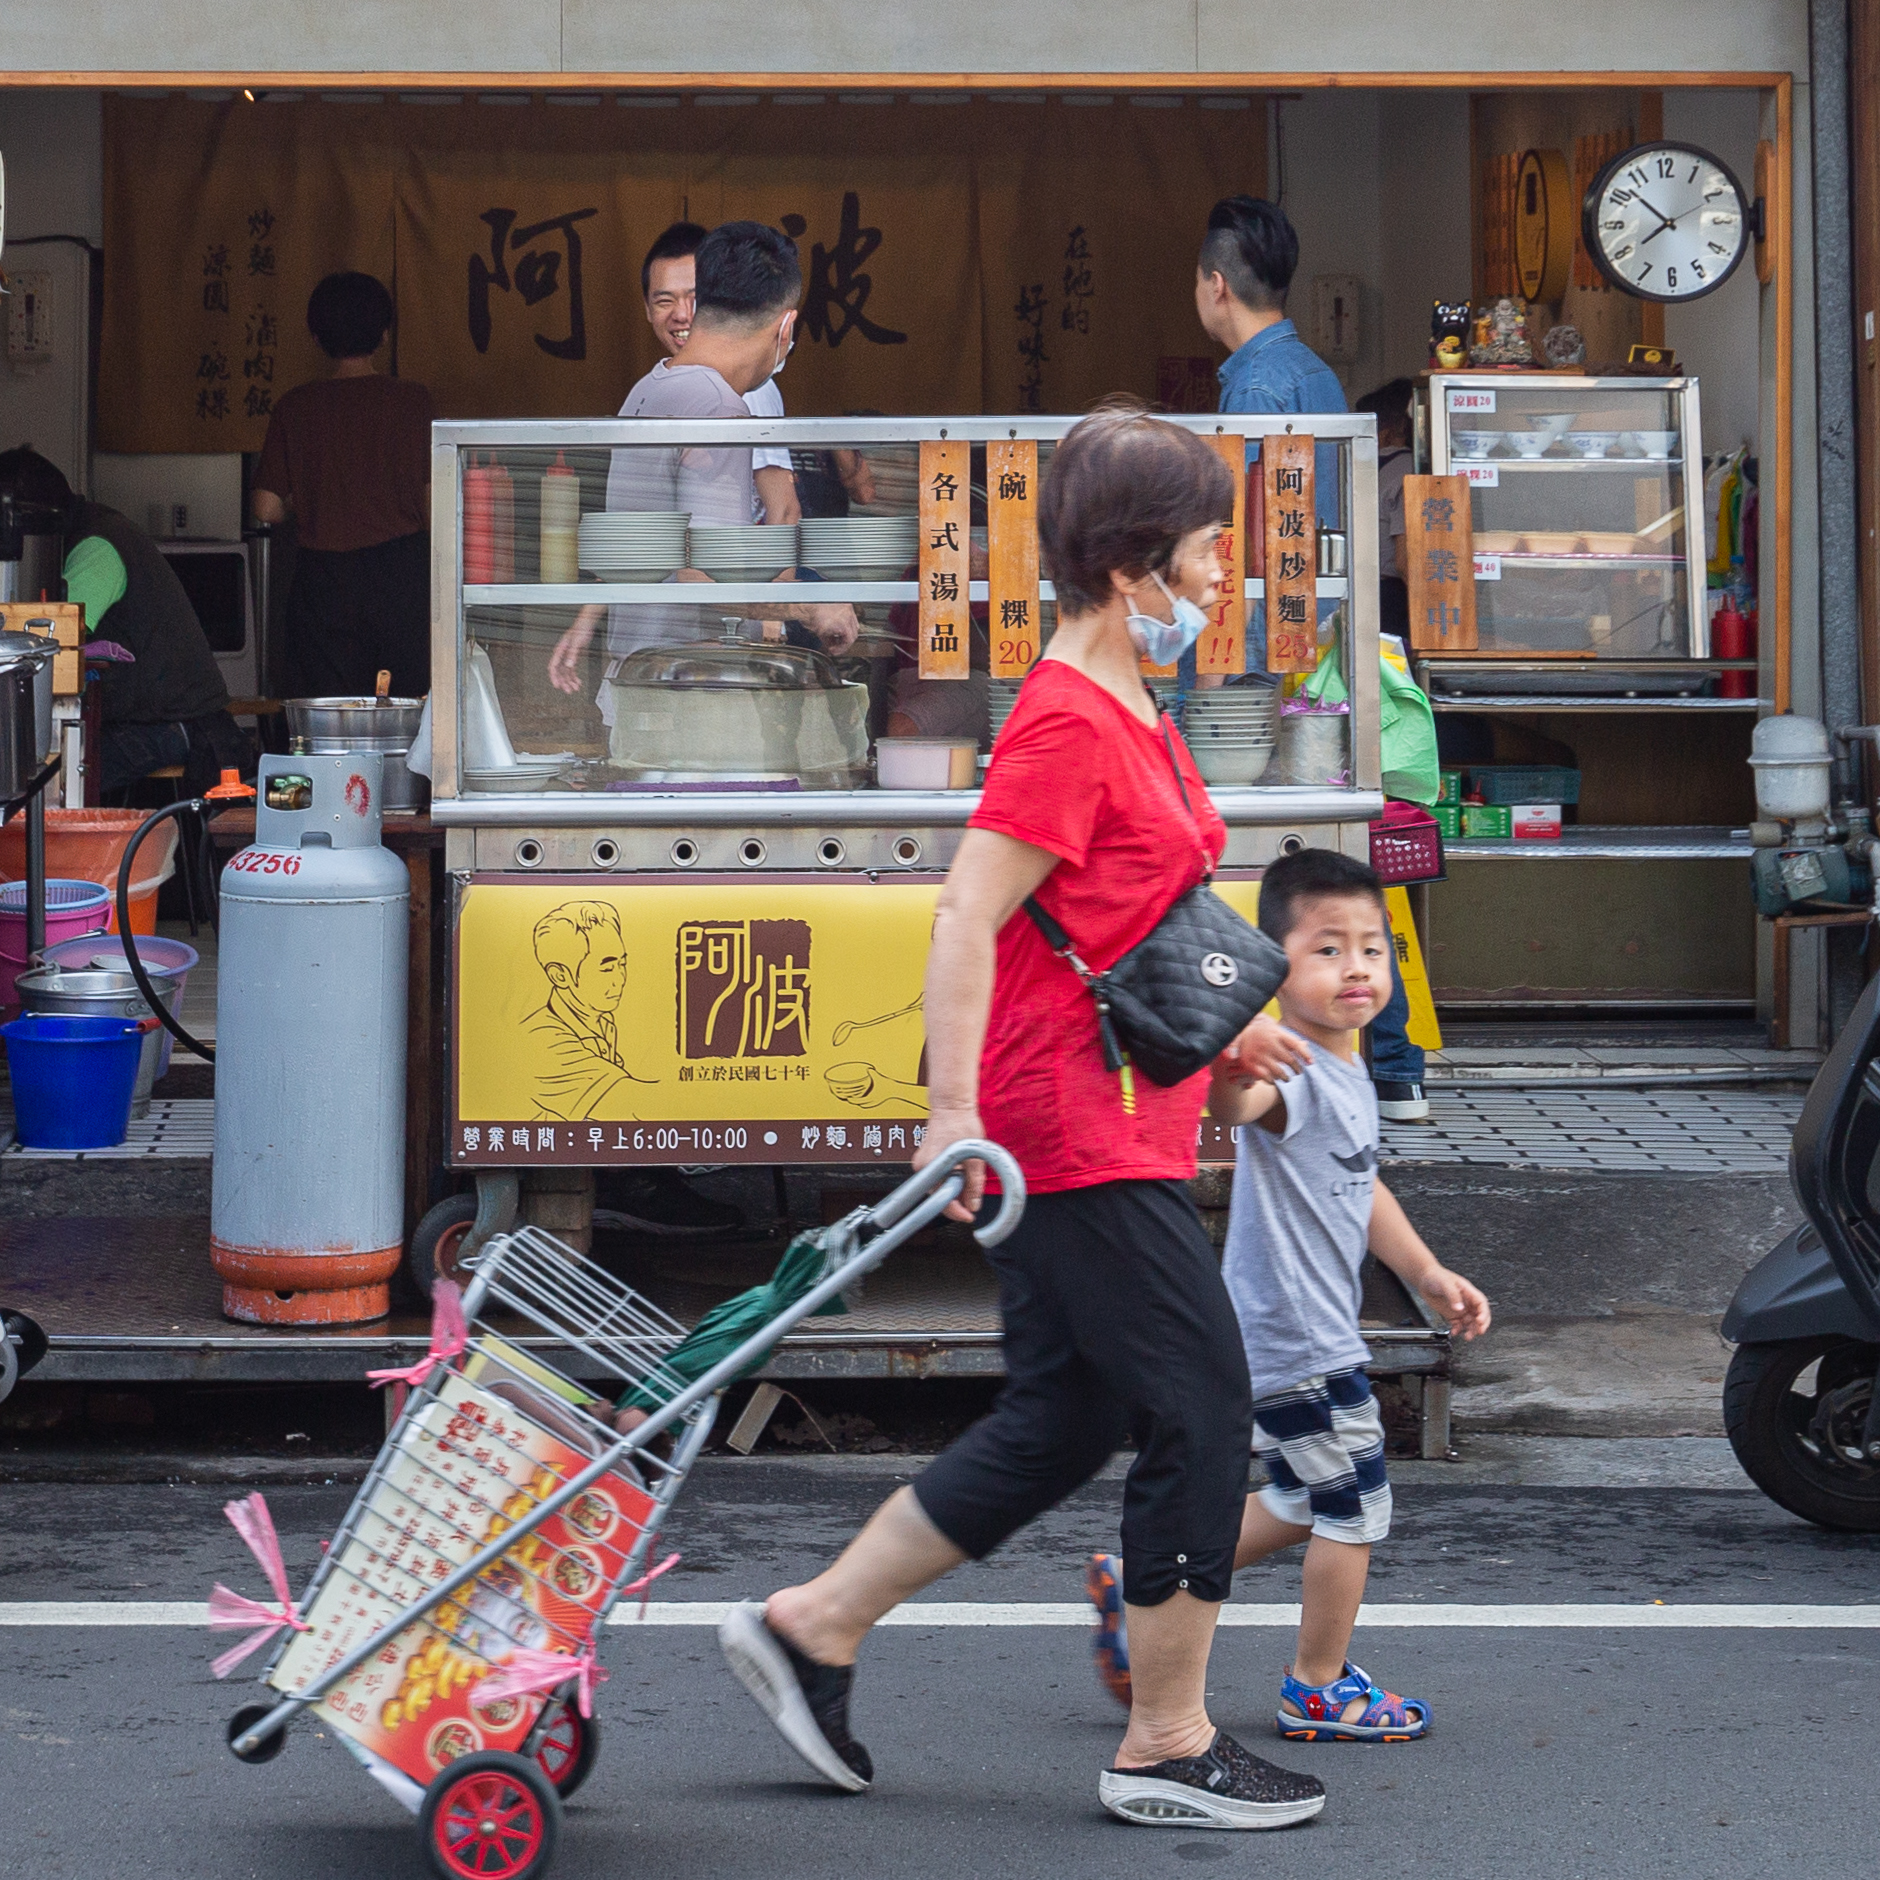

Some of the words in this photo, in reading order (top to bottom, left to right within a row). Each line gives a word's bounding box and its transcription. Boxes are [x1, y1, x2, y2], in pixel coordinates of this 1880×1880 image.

[1628, 166, 1649, 188] 11
[1657, 158, 1675, 179] 12
[1688, 166, 1700, 184] 1
[1609, 188, 1632, 208] 10
[1604, 220, 1625, 230] 9
[1614, 245, 1633, 260] 8
[1708, 241, 1724, 254] 4
[1637, 262, 1653, 281] 7
[1668, 267, 1676, 287] 6
[1690, 259, 1706, 278] 5
[998, 472, 1029, 629] 碗粿
[1276, 468, 1306, 624] 阿波炒麵
[930, 472, 959, 652] 各式湯品
[1421, 497, 1460, 636] 營業中
[999, 640, 1032, 665] 20
[1275, 634, 1309, 659] 25
[680, 920, 811, 1058] 阿波
[678, 1065, 810, 1082] 創立於民國七十年
